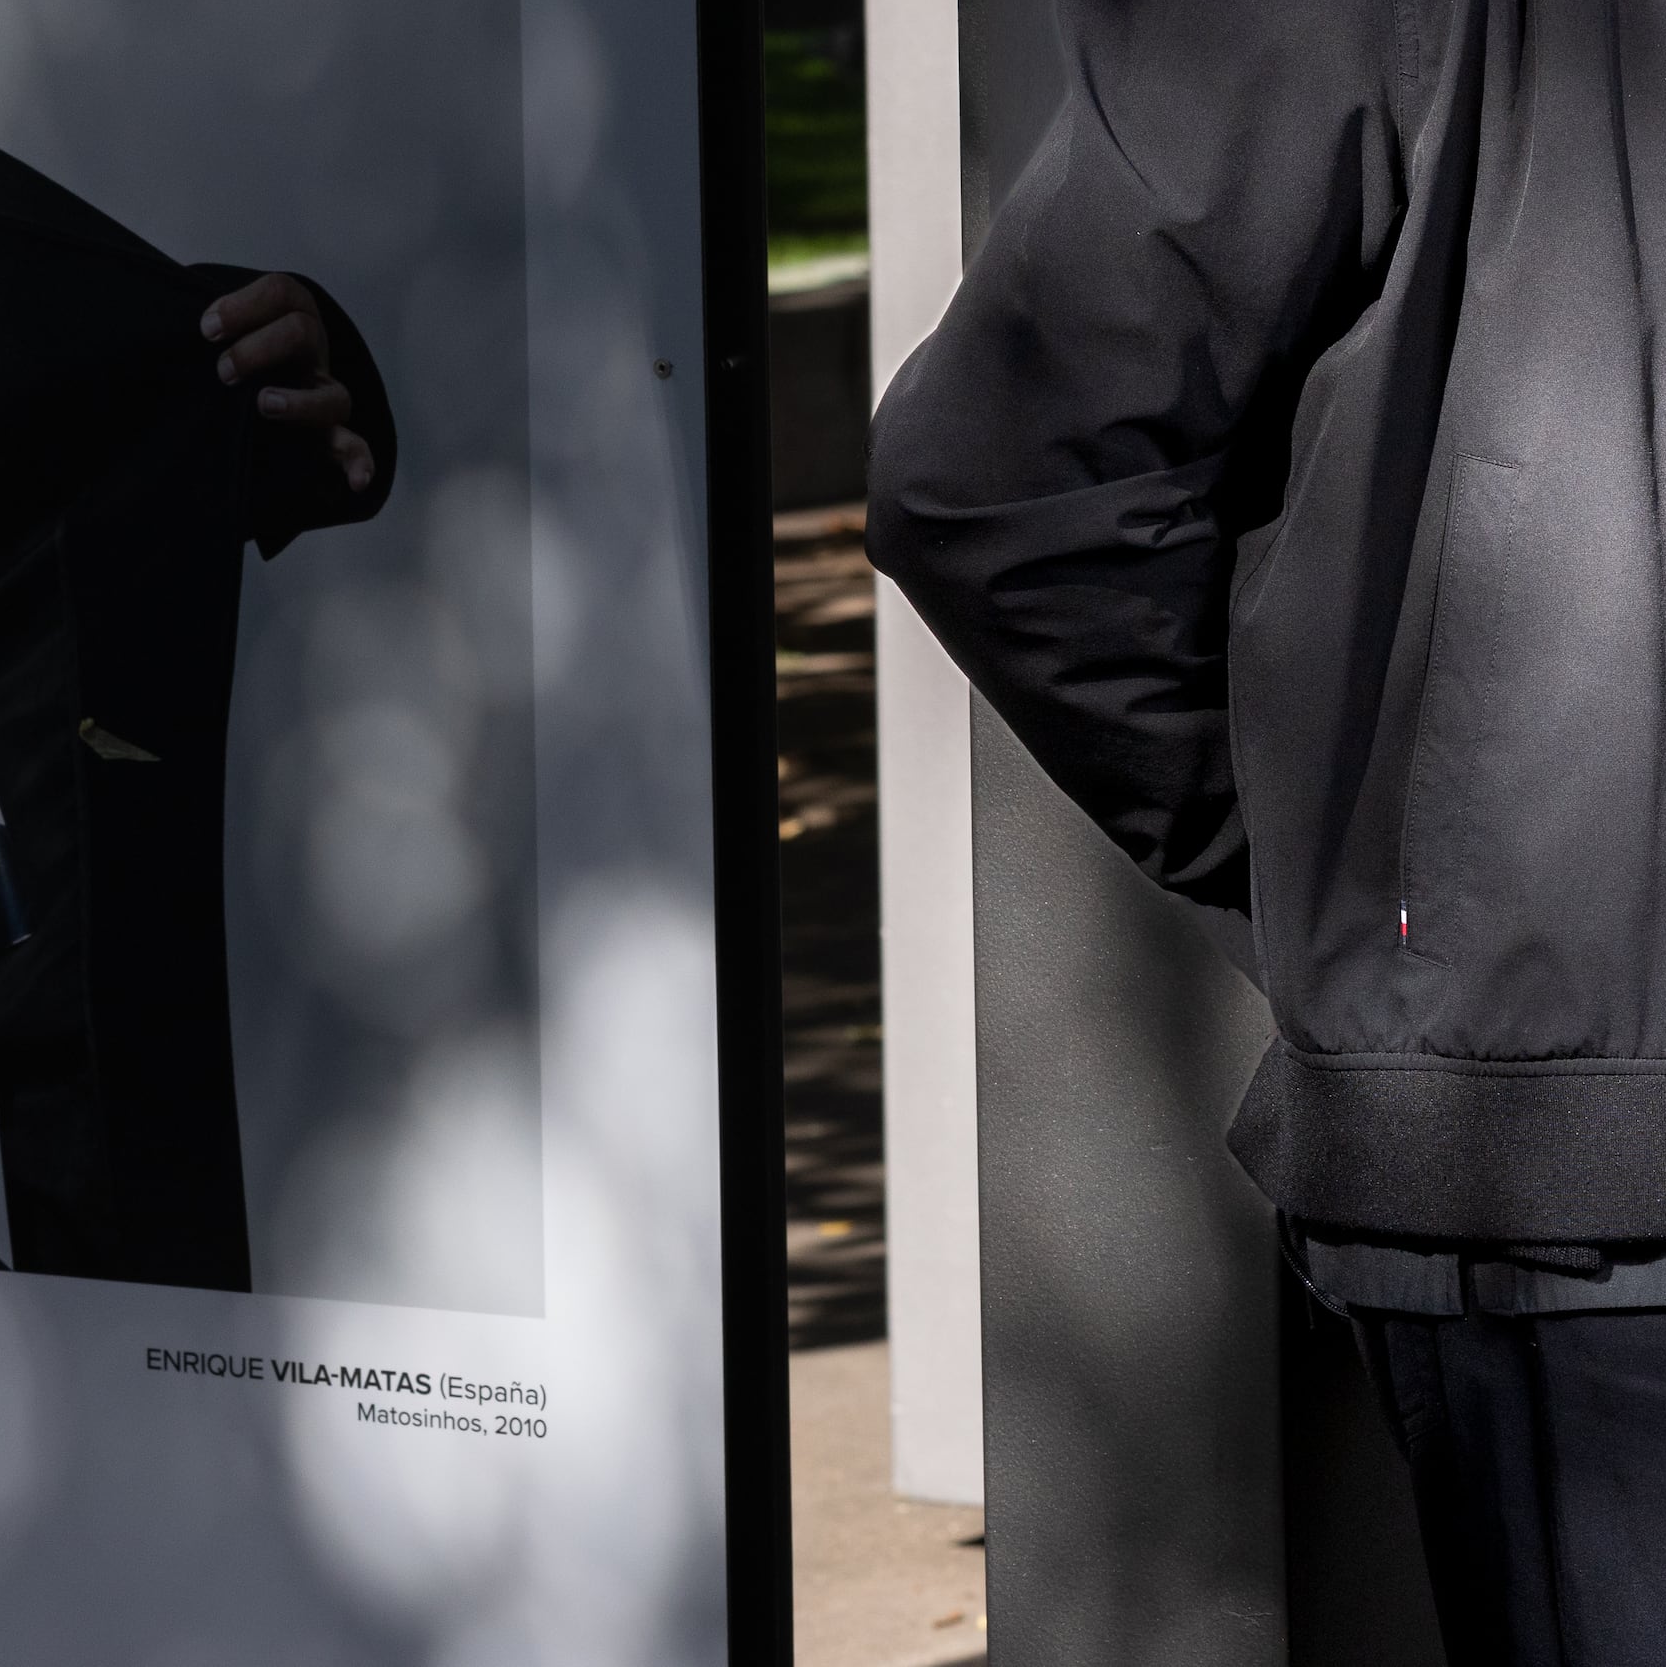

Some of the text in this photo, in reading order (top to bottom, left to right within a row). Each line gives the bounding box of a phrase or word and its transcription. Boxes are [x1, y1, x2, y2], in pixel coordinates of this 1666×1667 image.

[146, 1347, 547, 1411] ENRIQUE VILA-MATAS (España)
[357, 1402, 547, 1438] Matosinhos, 2010
